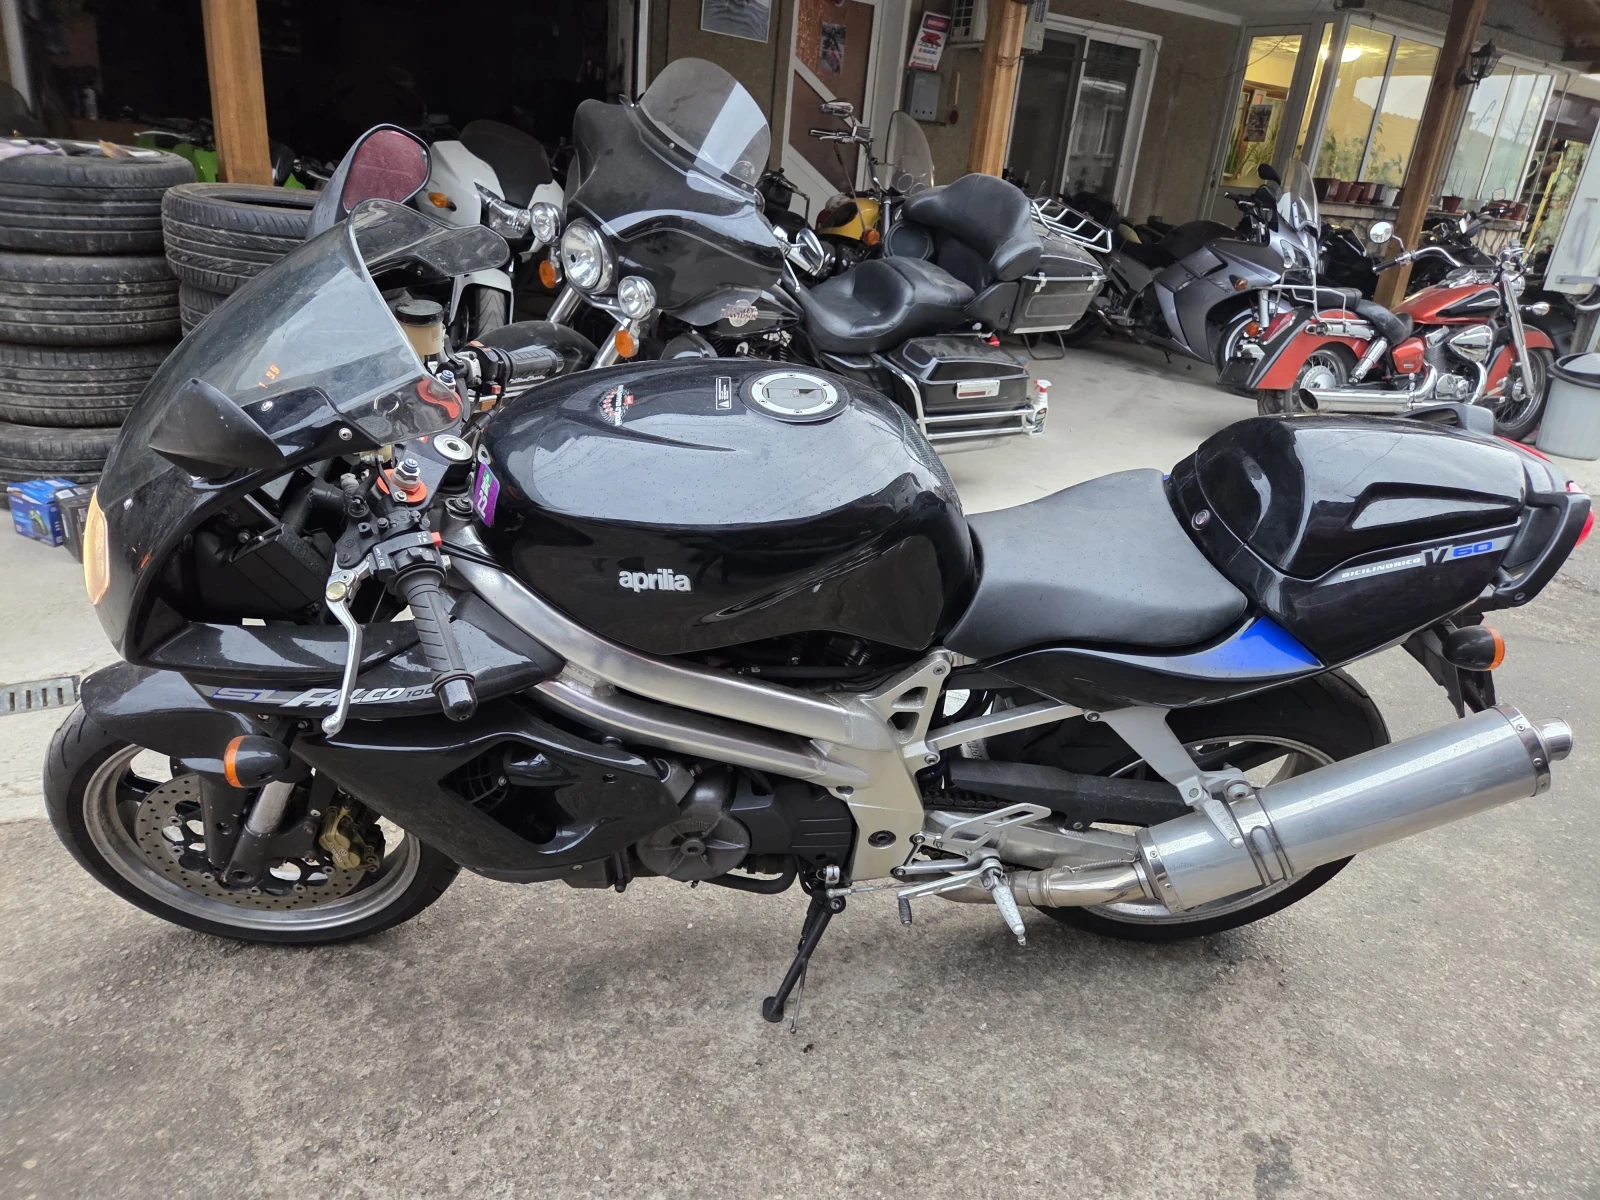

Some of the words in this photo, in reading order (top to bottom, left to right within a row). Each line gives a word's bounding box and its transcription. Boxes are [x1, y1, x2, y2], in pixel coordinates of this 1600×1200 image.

[1341, 557, 1421, 578] BICILINDRICO
[618, 568, 692, 593] aprilia
[211, 686, 285, 704] SL
[279, 687, 406, 707] FALCO
